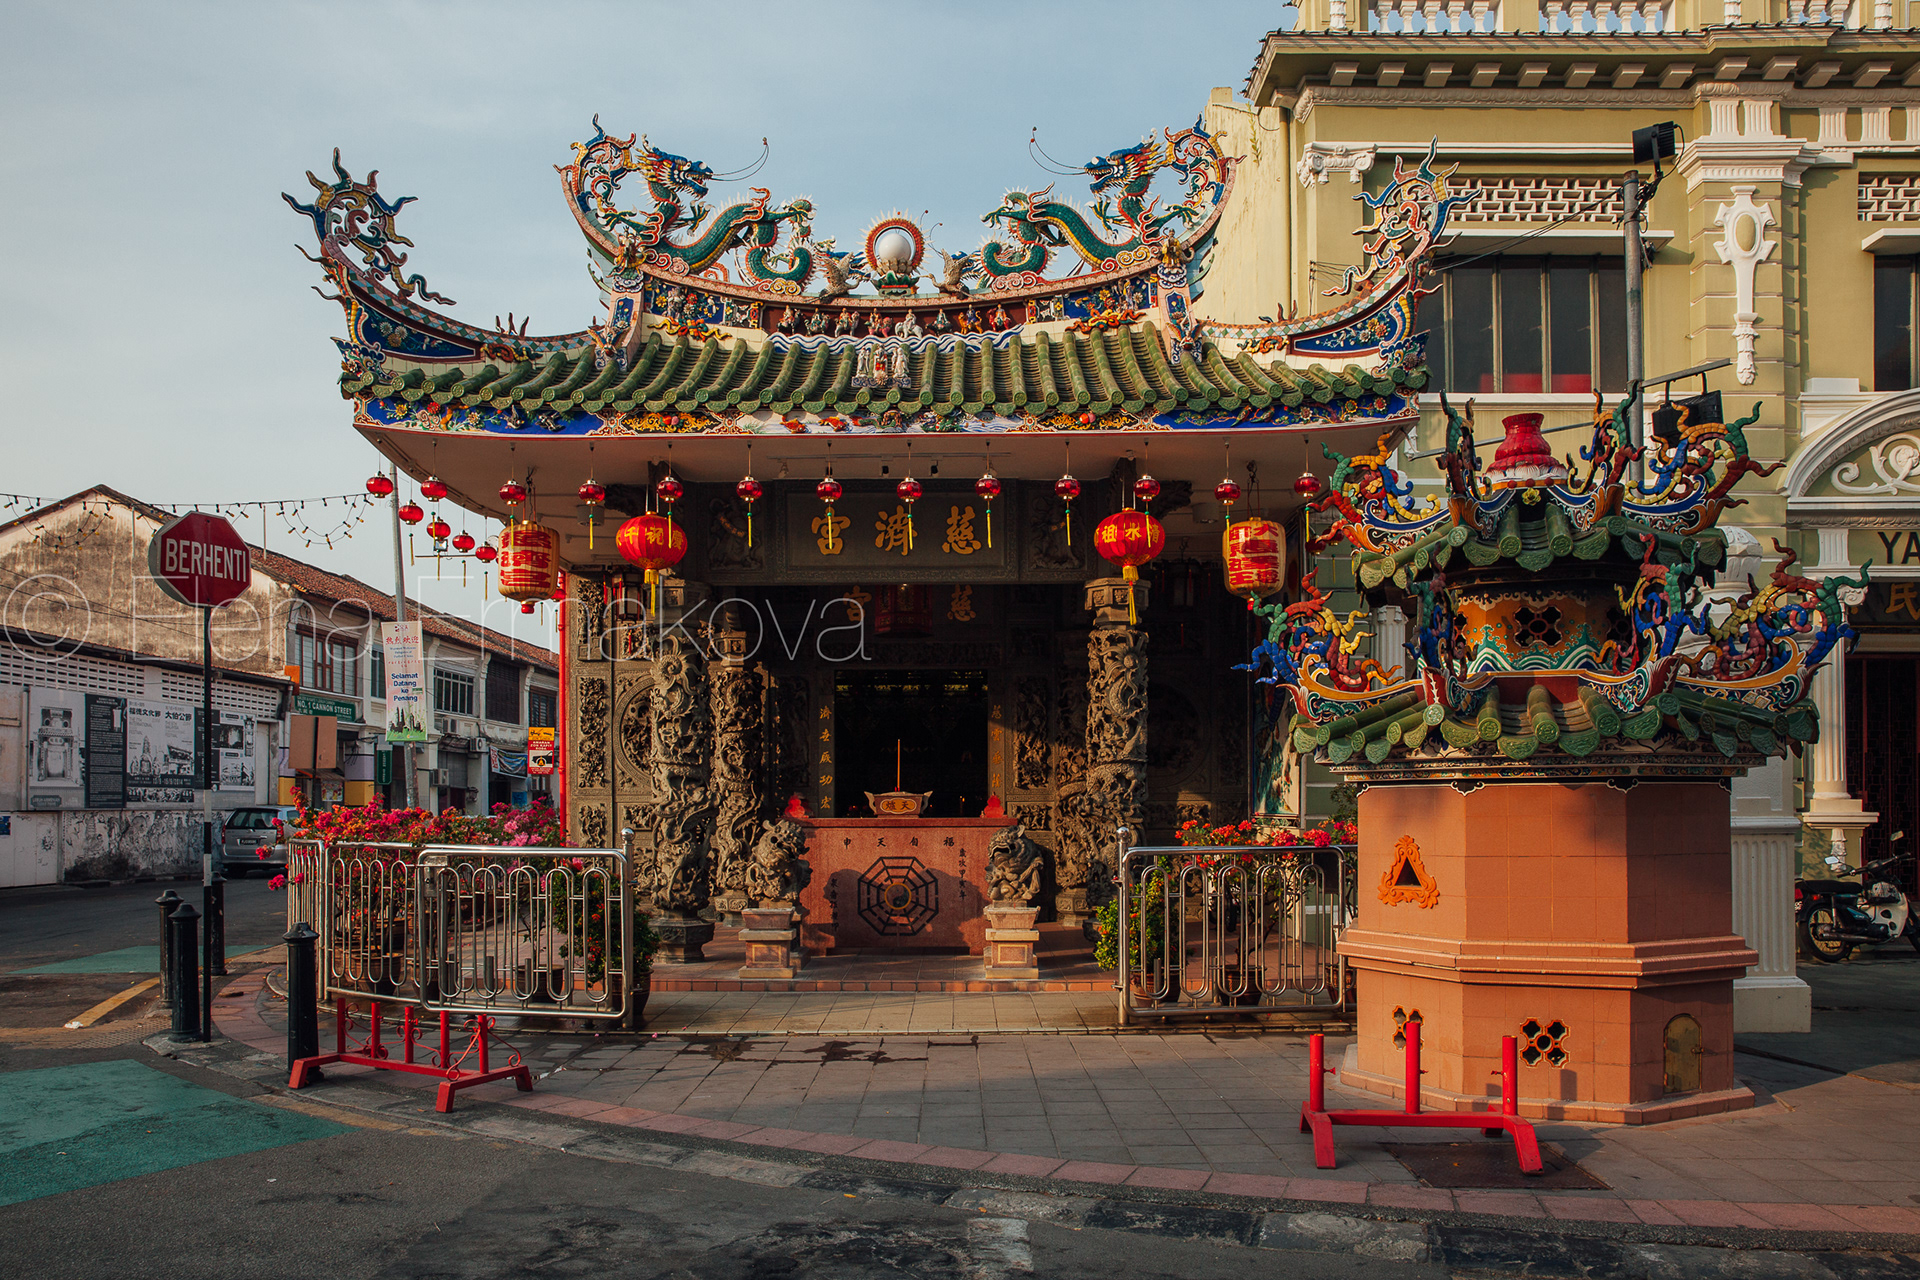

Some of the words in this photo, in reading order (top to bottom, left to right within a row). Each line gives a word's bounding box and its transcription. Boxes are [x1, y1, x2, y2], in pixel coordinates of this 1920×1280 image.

[165, 537, 247, 583] BERHENTI
[391, 672, 418, 680] Selamat
[297, 700, 307, 708] NO.
[312, 702, 334, 713] CANNON
[334, 705, 352, 715] STREET
